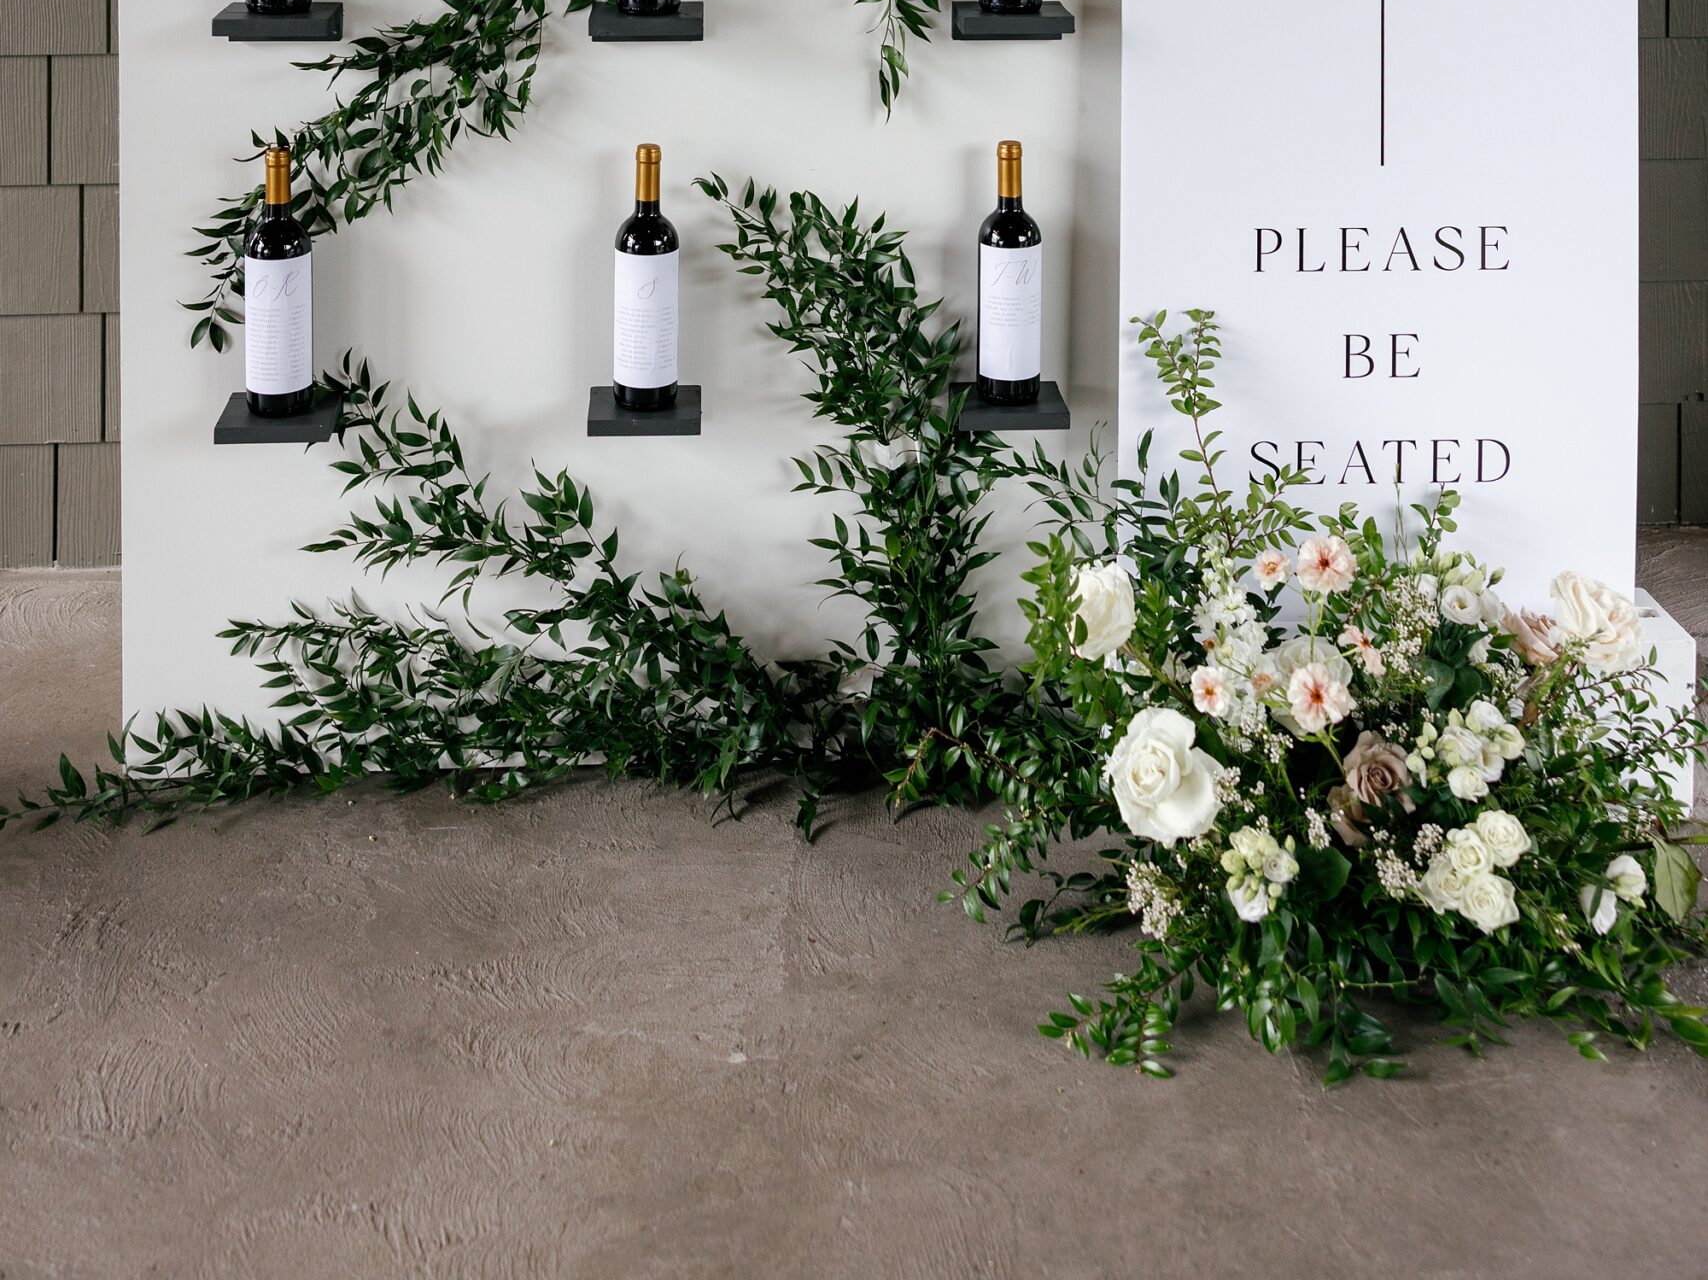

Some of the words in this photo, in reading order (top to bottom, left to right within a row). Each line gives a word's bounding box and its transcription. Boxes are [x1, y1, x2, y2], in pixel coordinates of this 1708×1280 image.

[1254, 226, 1509, 272] PLEASE
[1342, 334, 1420, 378] BE
[1249, 439, 1511, 485] SEATED
